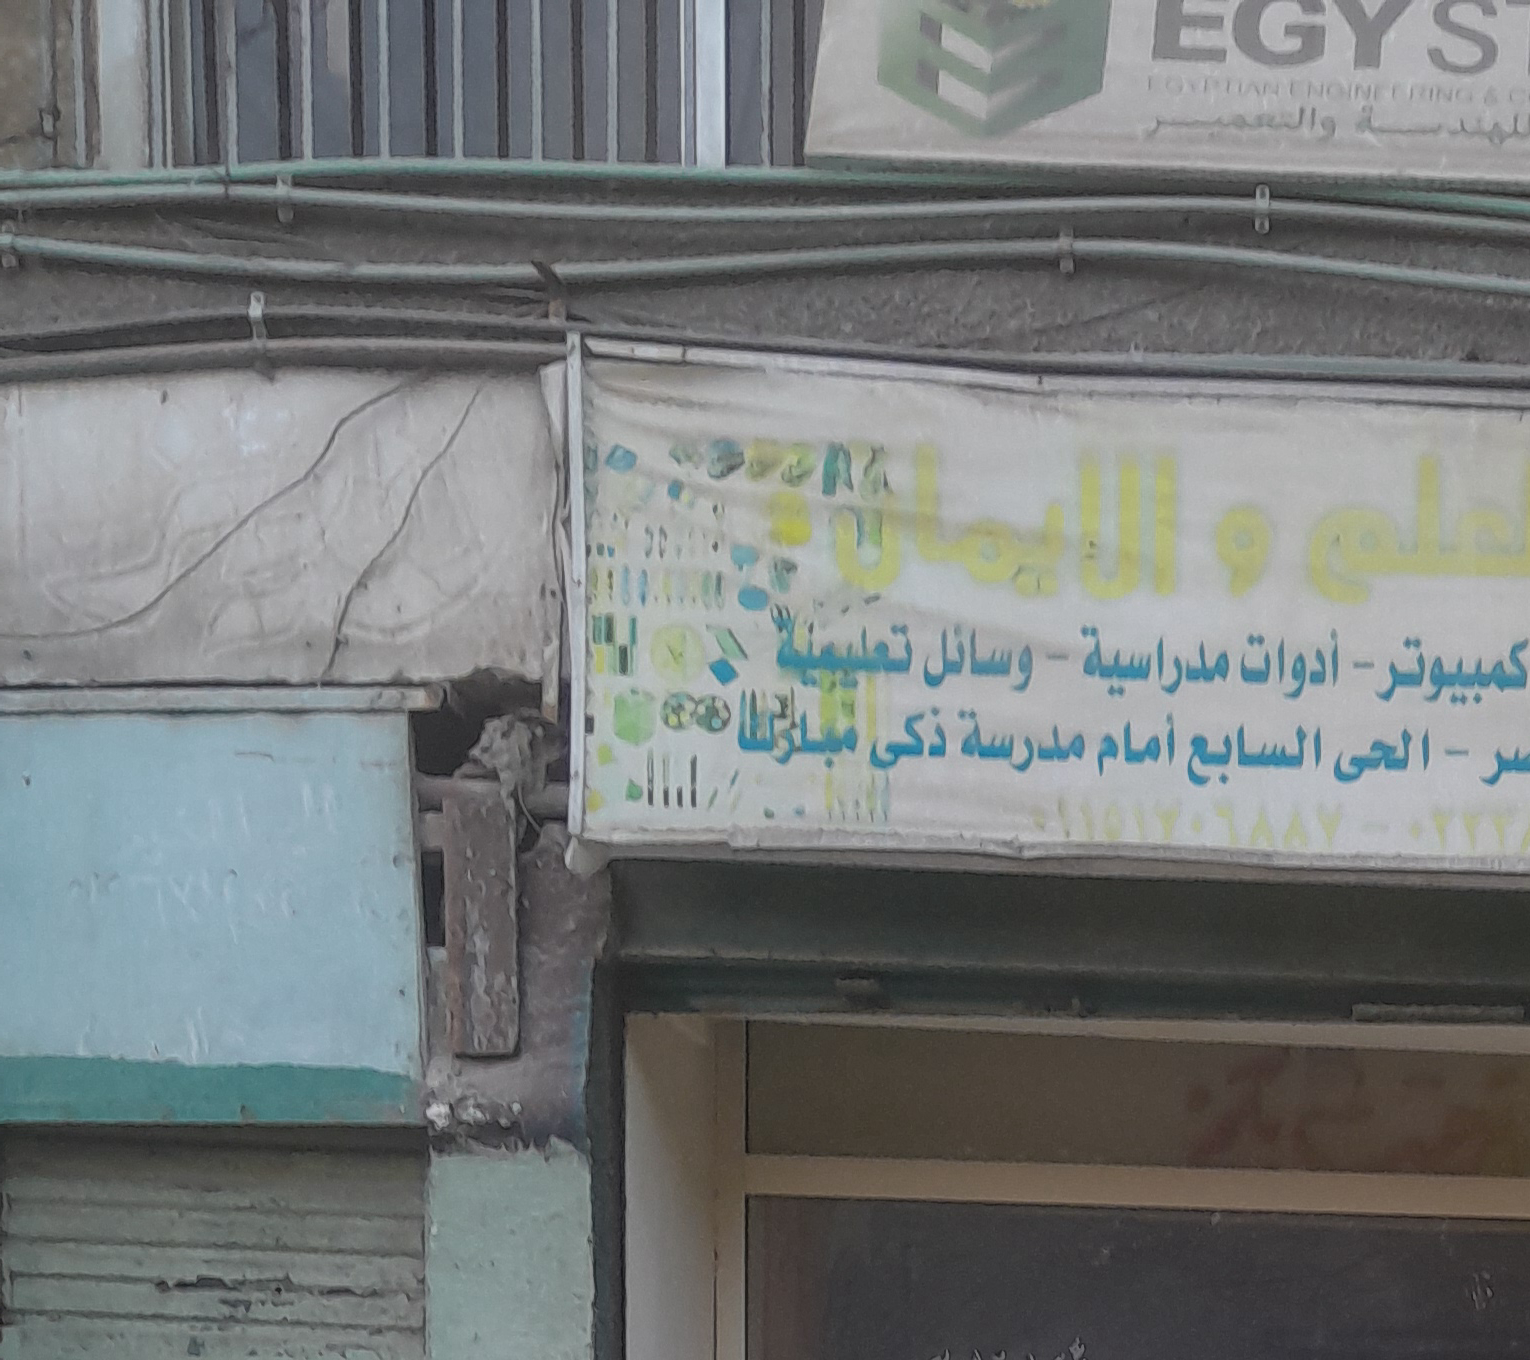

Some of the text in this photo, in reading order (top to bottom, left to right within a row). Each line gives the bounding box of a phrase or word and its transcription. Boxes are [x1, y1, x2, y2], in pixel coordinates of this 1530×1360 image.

[1215, 506, 1272, 599] و
[777, 616, 912, 690] تعليمية
[1240, 628, 1338, 700] أدوات
[1375, 636, 1528, 705] كمبيوتر
[959, 706, 1085, 773] مدرسة
[1097, 711, 1175, 777] أمام
[1187, 722, 1322, 787] السابع
